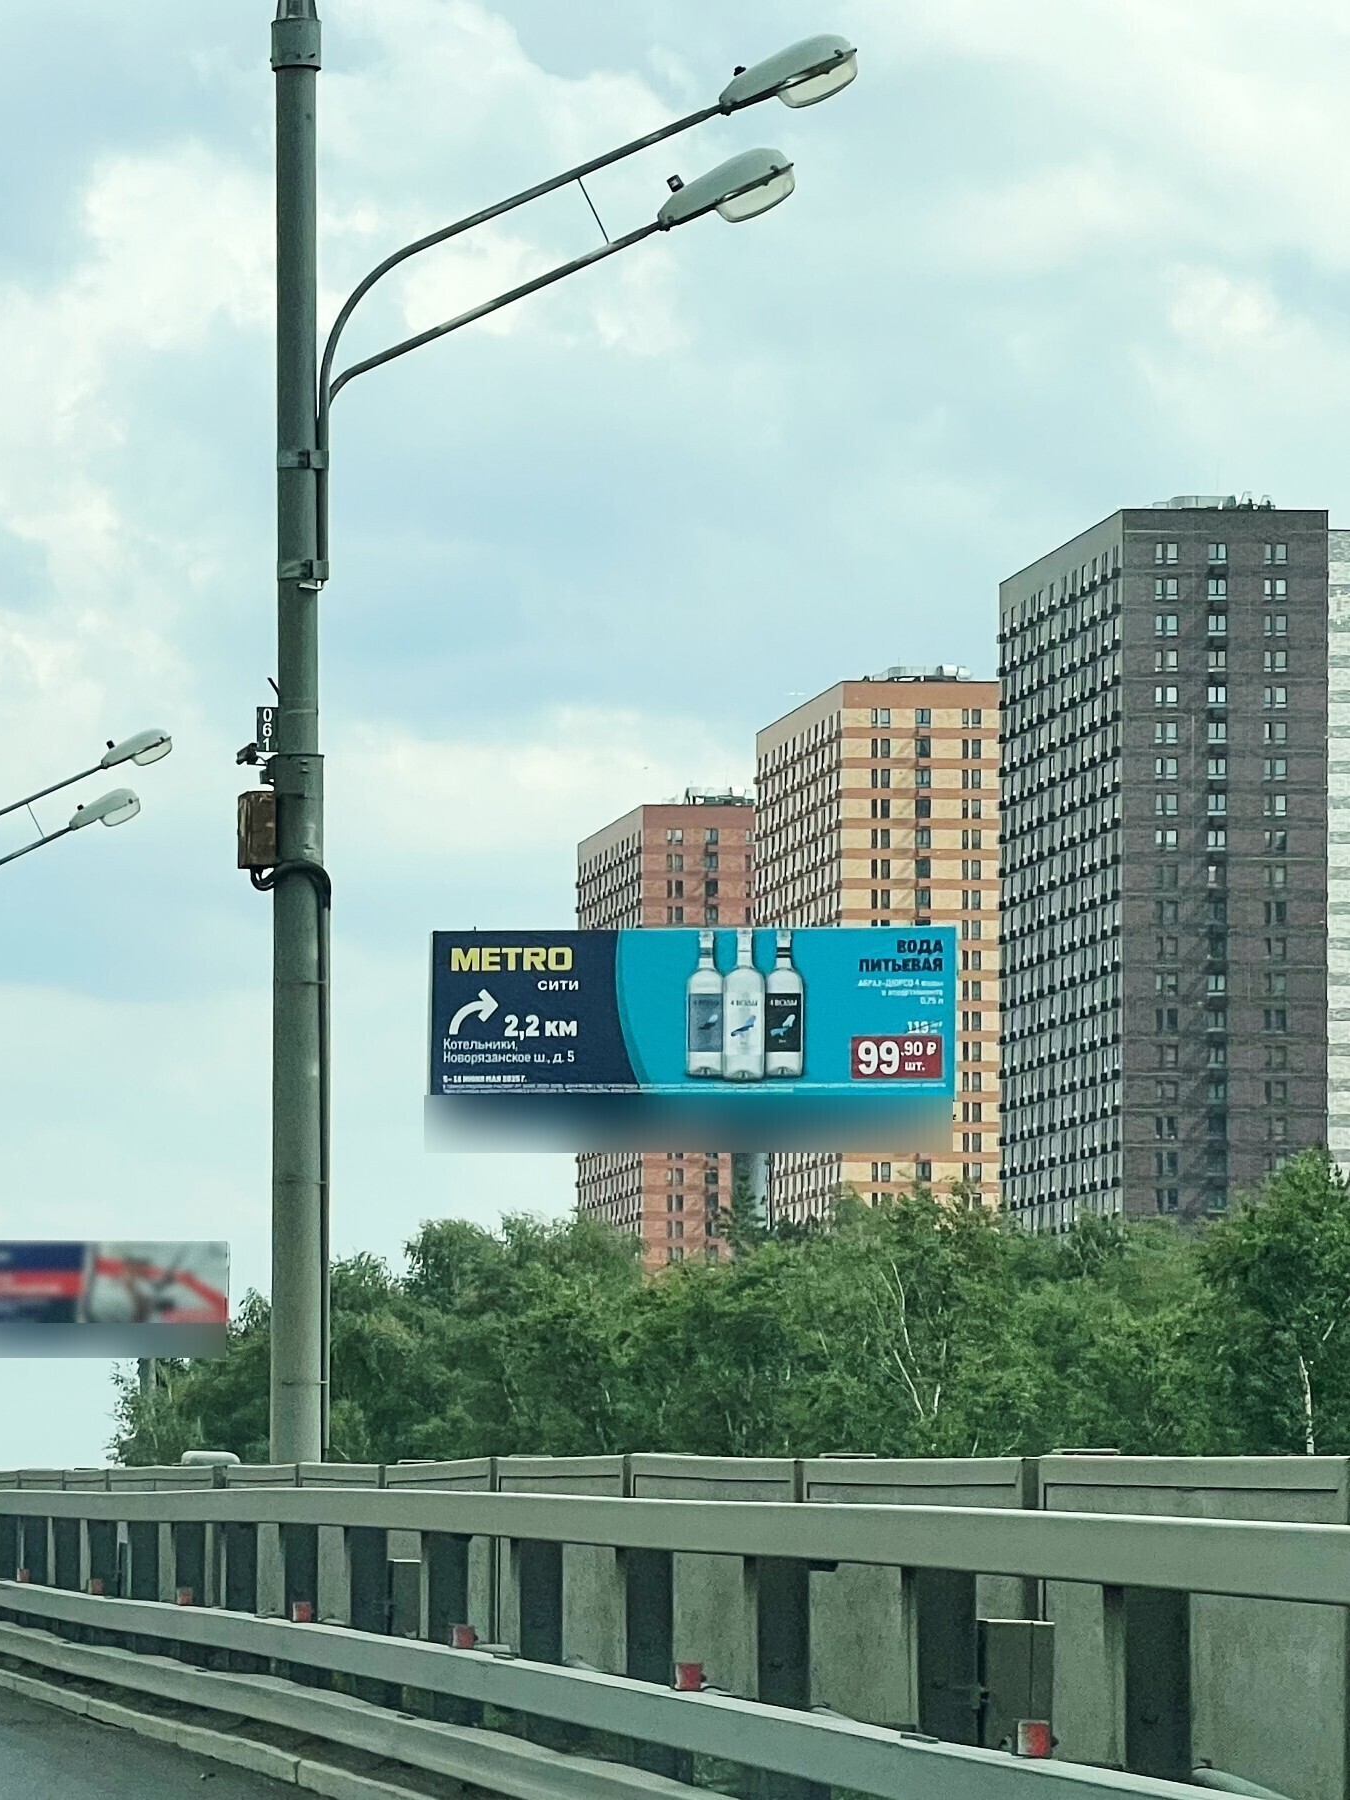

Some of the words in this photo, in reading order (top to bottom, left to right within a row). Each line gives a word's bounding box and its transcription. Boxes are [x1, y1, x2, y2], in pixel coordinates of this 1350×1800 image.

[262, 708, 273, 752] 061
[896, 939, 944, 956] ВОДА
[450, 946, 573, 972] METRO
[858, 957, 944, 973] ПИТЬЕВАЯ
[504, 1014, 540, 1041] 2,2
[442, 1038, 518, 1052] Котельники,
[442, 1051, 532, 1066] Новорязанское
[552, 1053, 564, 1064] д.
[567, 1050, 575, 1063] 5
[904, 1061, 926, 1071] шт.
